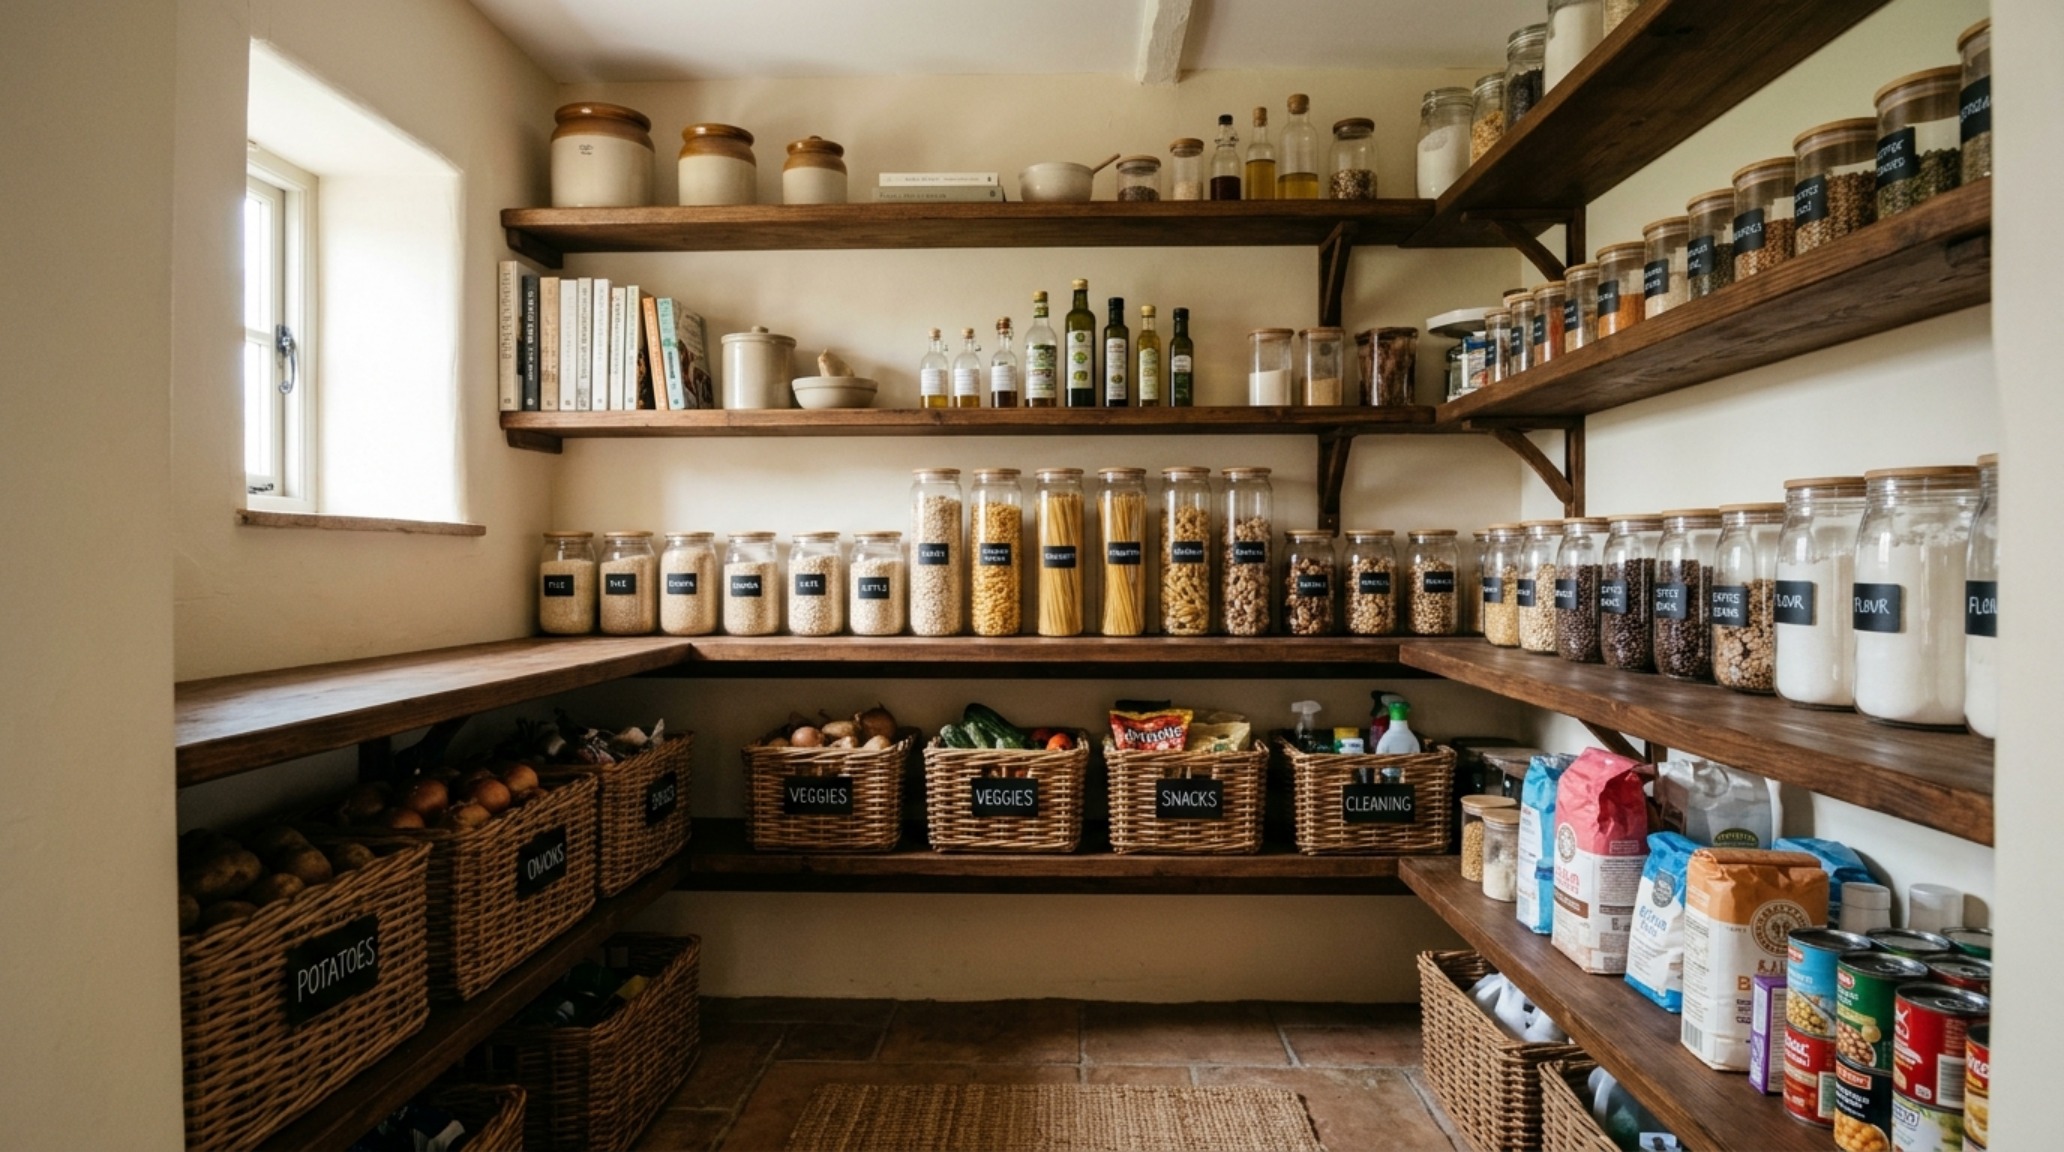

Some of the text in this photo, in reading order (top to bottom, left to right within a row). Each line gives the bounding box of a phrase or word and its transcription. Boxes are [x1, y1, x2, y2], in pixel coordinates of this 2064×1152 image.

[789, 787, 848, 805] VEGGIES
[975, 789, 1034, 806] VEGGIES
[1161, 790, 1218, 808] SNACKS
[1345, 796, 1412, 812] CLEANING
[297, 936, 375, 1003] POTATOES
